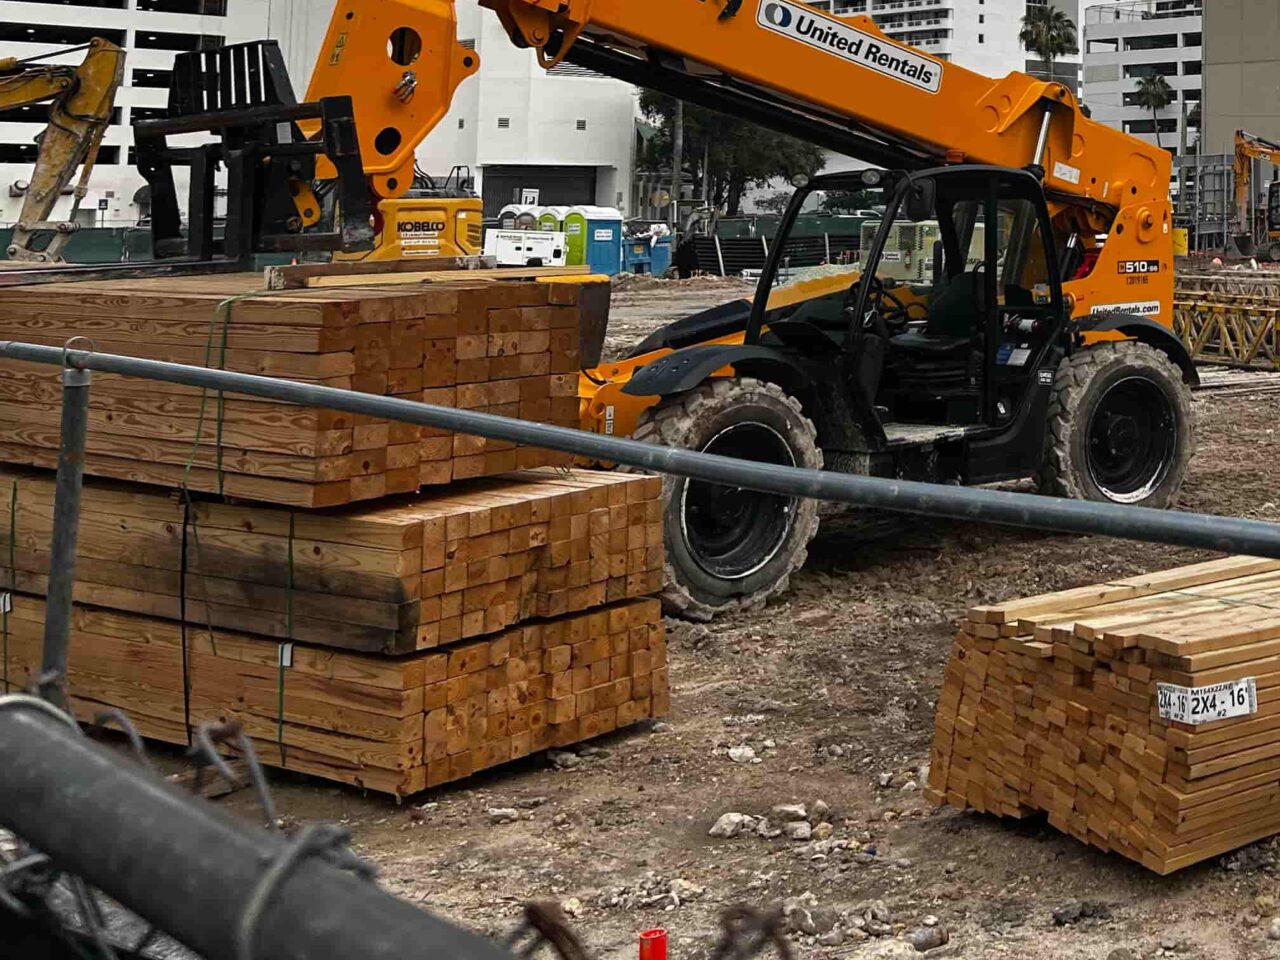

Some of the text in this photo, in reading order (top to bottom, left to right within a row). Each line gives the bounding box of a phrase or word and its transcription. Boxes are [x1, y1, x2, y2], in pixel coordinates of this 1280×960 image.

[795, 15, 934, 85] United Rentals
[397, 221, 445, 232] KOBELCO
[1159, 690, 1171, 708] 2X4
[1191, 694, 1217, 715] 2X4
[1230, 688, 1248, 707] 16'
